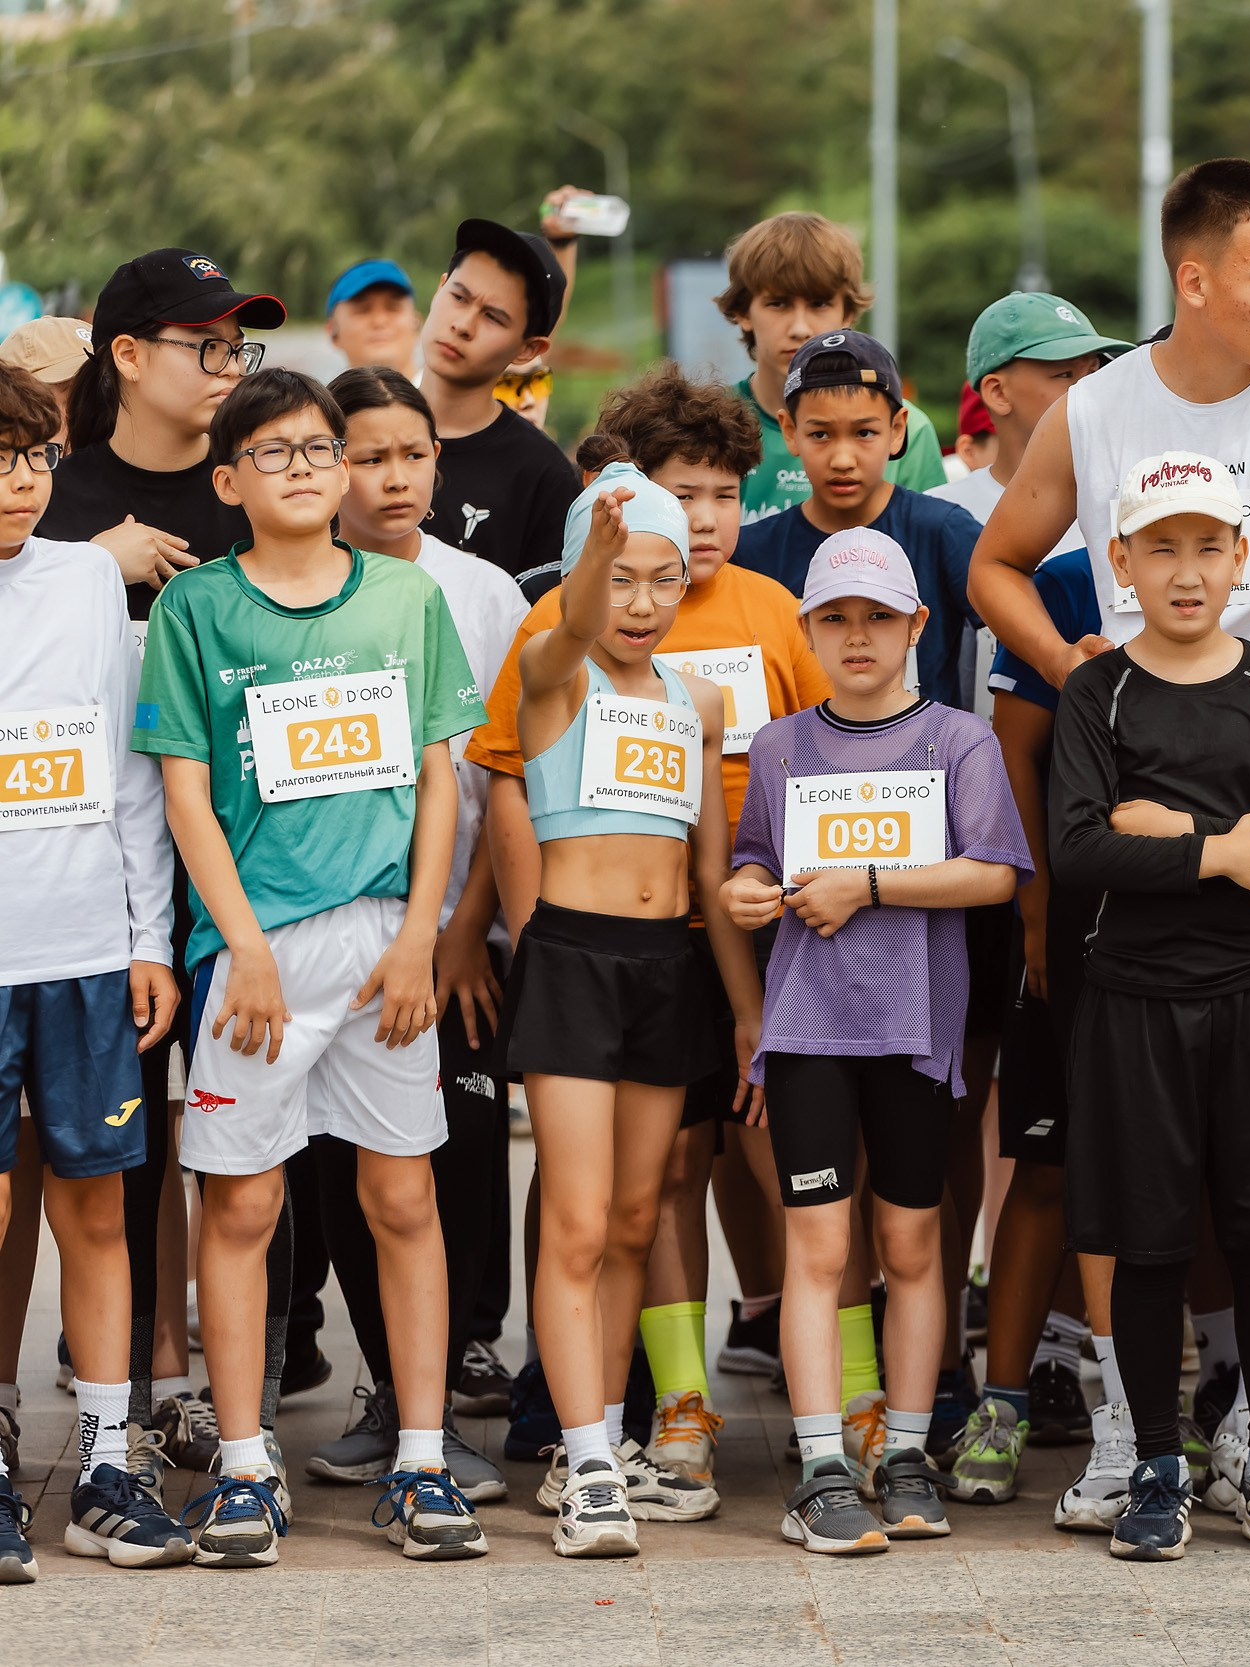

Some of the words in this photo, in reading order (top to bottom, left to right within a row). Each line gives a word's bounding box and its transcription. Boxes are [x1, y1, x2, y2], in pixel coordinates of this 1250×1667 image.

[1160, 479, 1189, 489] VINTAGE
[703, 661, 749, 676] D'ORO
[262, 695, 319, 715] LEONE
[347, 686, 393, 703] D'ORO
[56, 721, 95, 737] D'ORO
[600, 708, 648, 727] LEONE
[669, 719, 697, 738] D'ORO
[297, 721, 371, 763] 243
[623, 743, 681, 785] 235
[5, 755, 75, 795] 437
[275, 767, 374, 789] БЛАГОТВОРИТЕЛЬНЫЙ
[375, 765, 401, 776] ЗАБЕГ
[596, 787, 680, 806] БЛАГОТВОРИТЕЛЬНЫЙ
[679, 799, 694, 810] ЗАБЕГ
[799, 788, 852, 804] LEONE
[882, 785, 930, 799] D'ORO
[79, 801, 100, 811] ЗАБЕГ
[827, 817, 901, 853] 099
[455, 1076, 486, 1090] NORTH
[472, 1071, 487, 1081] THE
[464, 1084, 486, 1095] FACE
